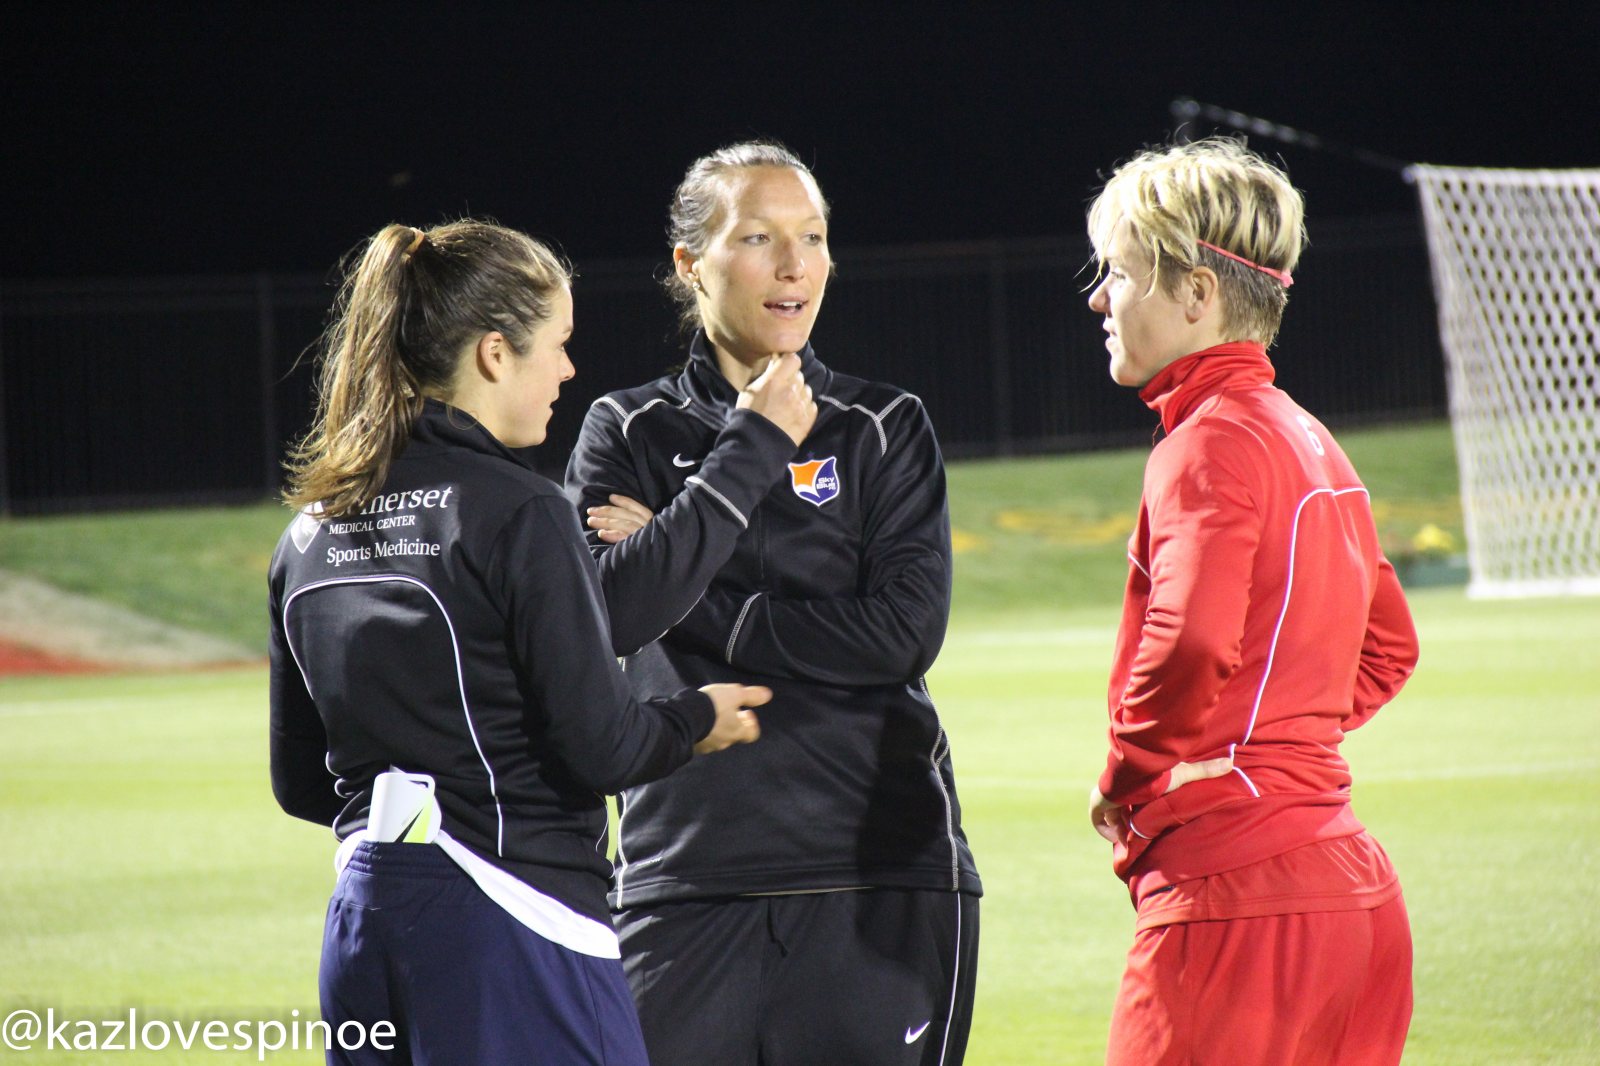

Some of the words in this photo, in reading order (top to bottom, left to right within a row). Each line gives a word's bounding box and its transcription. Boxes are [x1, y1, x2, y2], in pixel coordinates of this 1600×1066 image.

[1295, 414, 1325, 457] 6
[333, 486, 453, 517] merset
[328, 521, 375, 535] MEDICAL
[376, 515, 416, 530] CENTER
[326, 546, 371, 567] Sports
[374, 538, 440, 558] Medicine
